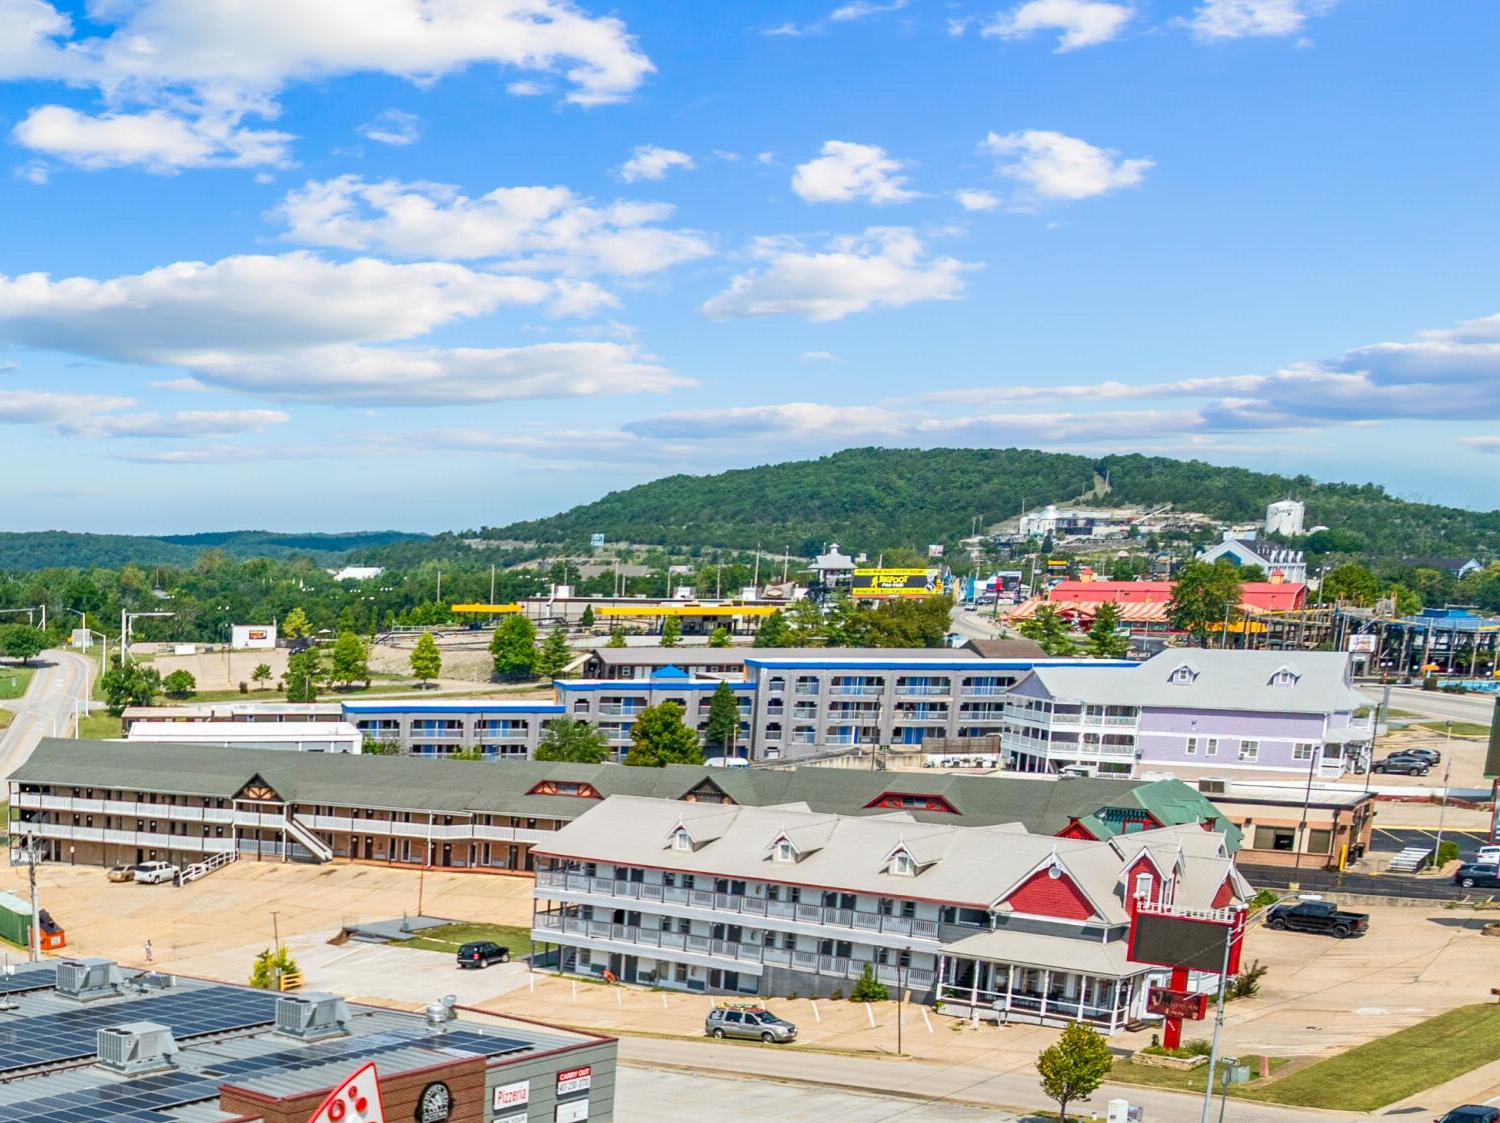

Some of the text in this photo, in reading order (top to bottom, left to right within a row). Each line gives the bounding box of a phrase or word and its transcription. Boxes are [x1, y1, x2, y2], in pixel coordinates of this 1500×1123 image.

[560, 1068, 590, 1081] CARRY OUT
[498, 1087, 526, 1104] Pizzeria
